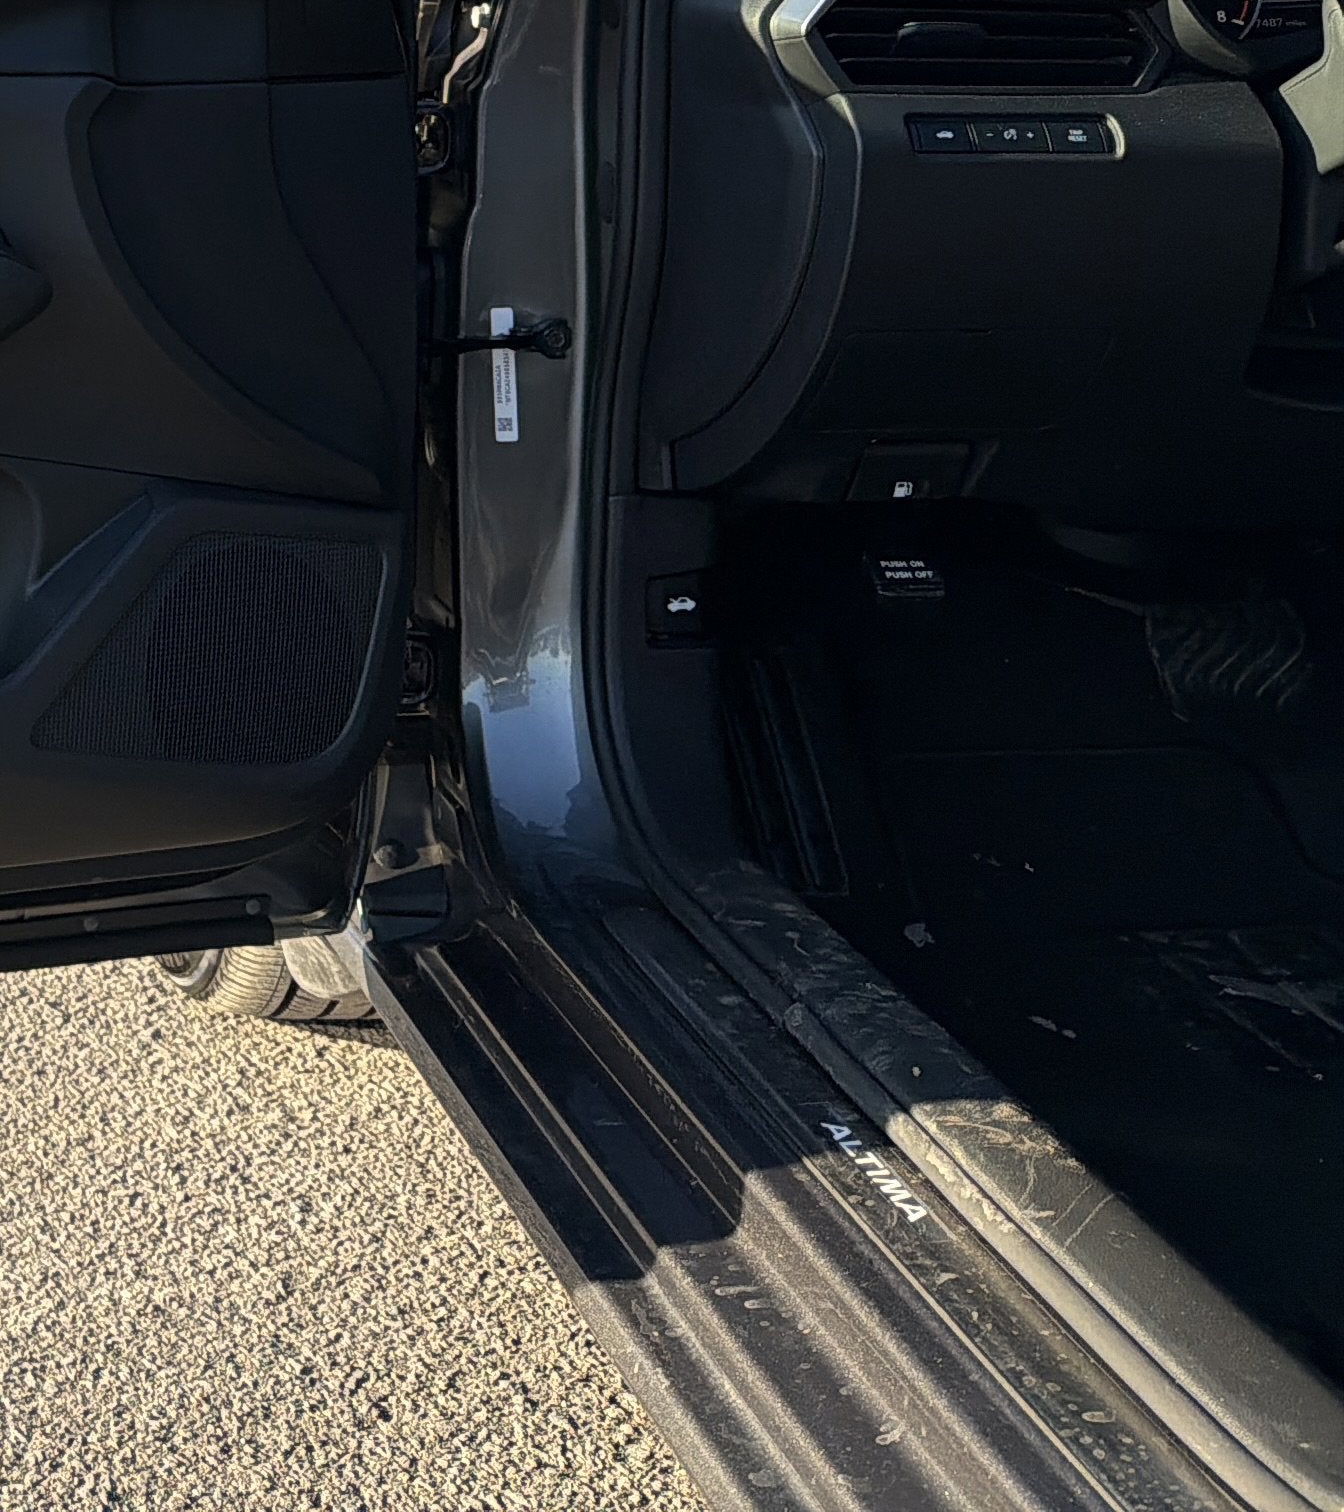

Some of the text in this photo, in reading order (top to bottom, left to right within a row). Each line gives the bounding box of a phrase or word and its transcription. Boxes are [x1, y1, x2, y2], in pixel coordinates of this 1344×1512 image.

[1216, 10, 1227, 23] 8
[879, 560, 925, 568] PUSH ON
[885, 571, 933, 579] PUSH OFF
[819, 1120, 928, 1223] ALTIMA
